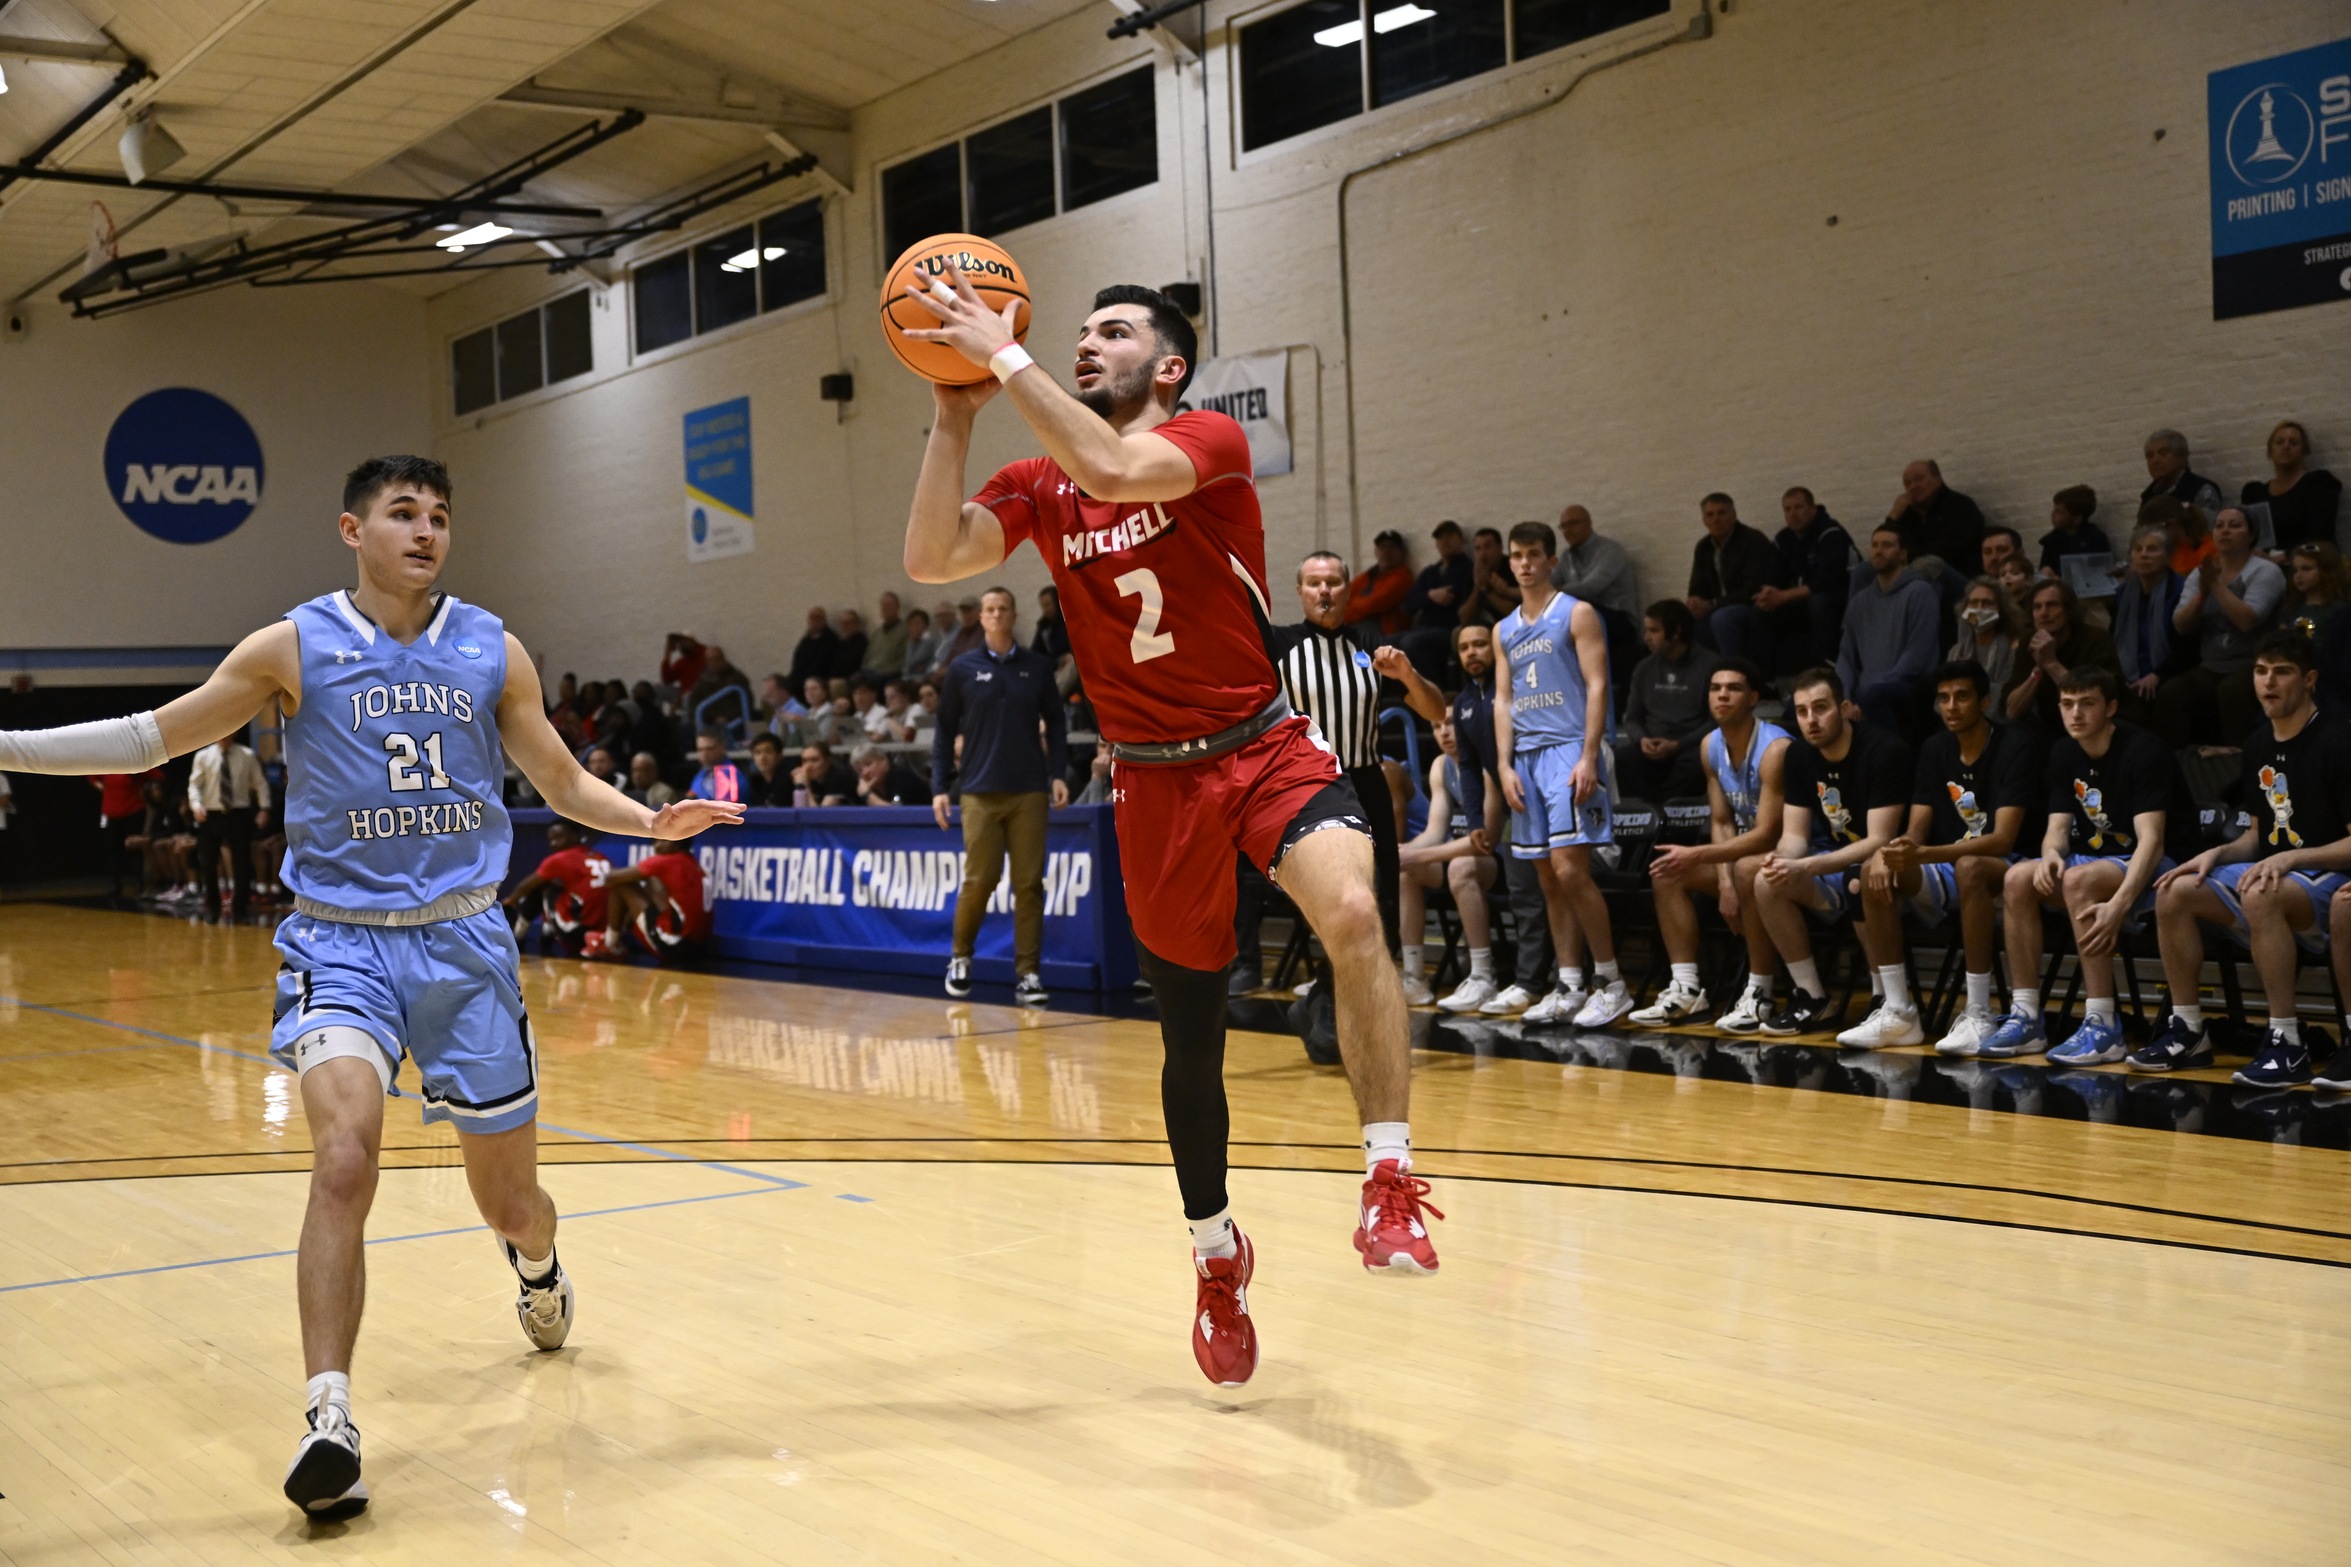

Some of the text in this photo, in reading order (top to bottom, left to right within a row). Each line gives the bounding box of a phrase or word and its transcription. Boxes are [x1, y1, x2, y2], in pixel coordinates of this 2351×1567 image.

[2228, 186, 2296, 222] PRINTING
[914, 251, 1017, 284] Wlson
[122, 464, 258, 505] NCAA
[1113, 567, 1176, 664] 2
[457, 644, 482, 655] NCAA
[1525, 661, 1539, 689] 4
[350, 681, 474, 732] JOHNS
[1514, 691, 1564, 713] OPKINS
[383, 731, 452, 793] 21
[347, 800, 485, 841] HOPKINS
[700, 846, 846, 907] BASKETBALL
[851, 849, 1092, 917] CHAMPNHIP
